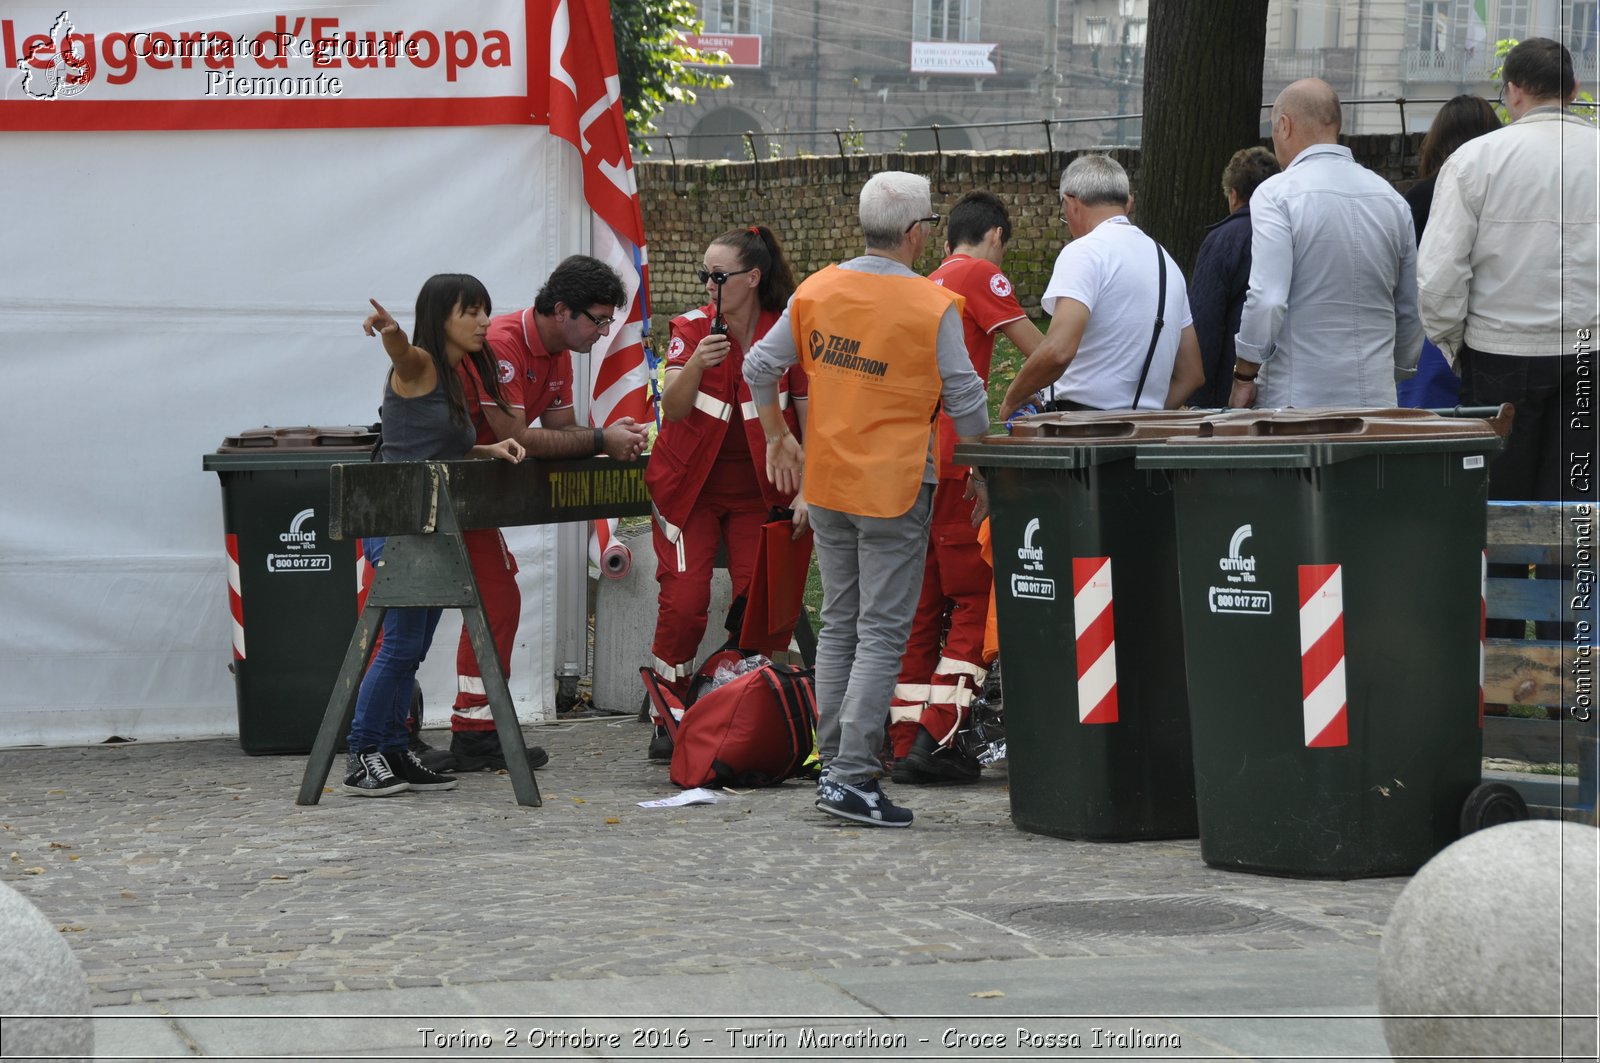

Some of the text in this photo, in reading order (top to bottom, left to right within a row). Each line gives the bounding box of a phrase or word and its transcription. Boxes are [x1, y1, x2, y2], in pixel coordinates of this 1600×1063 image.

[698, 37, 734, 46] MACBETH
[1, 20, 235, 84] leggera
[828, 334, 861, 355] TEAM
[822, 349, 889, 377] MARATHON
[549, 470, 590, 508] TURIN
[279, 530, 316, 542] amiat
[1017, 546, 1043, 560] amiat
[275, 559, 327, 568] 800 017 277
[1219, 555, 1256, 571] amiat
[1017, 581, 1052, 594] 800 017 277
[1217, 595, 1267, 608] 800 017 277
